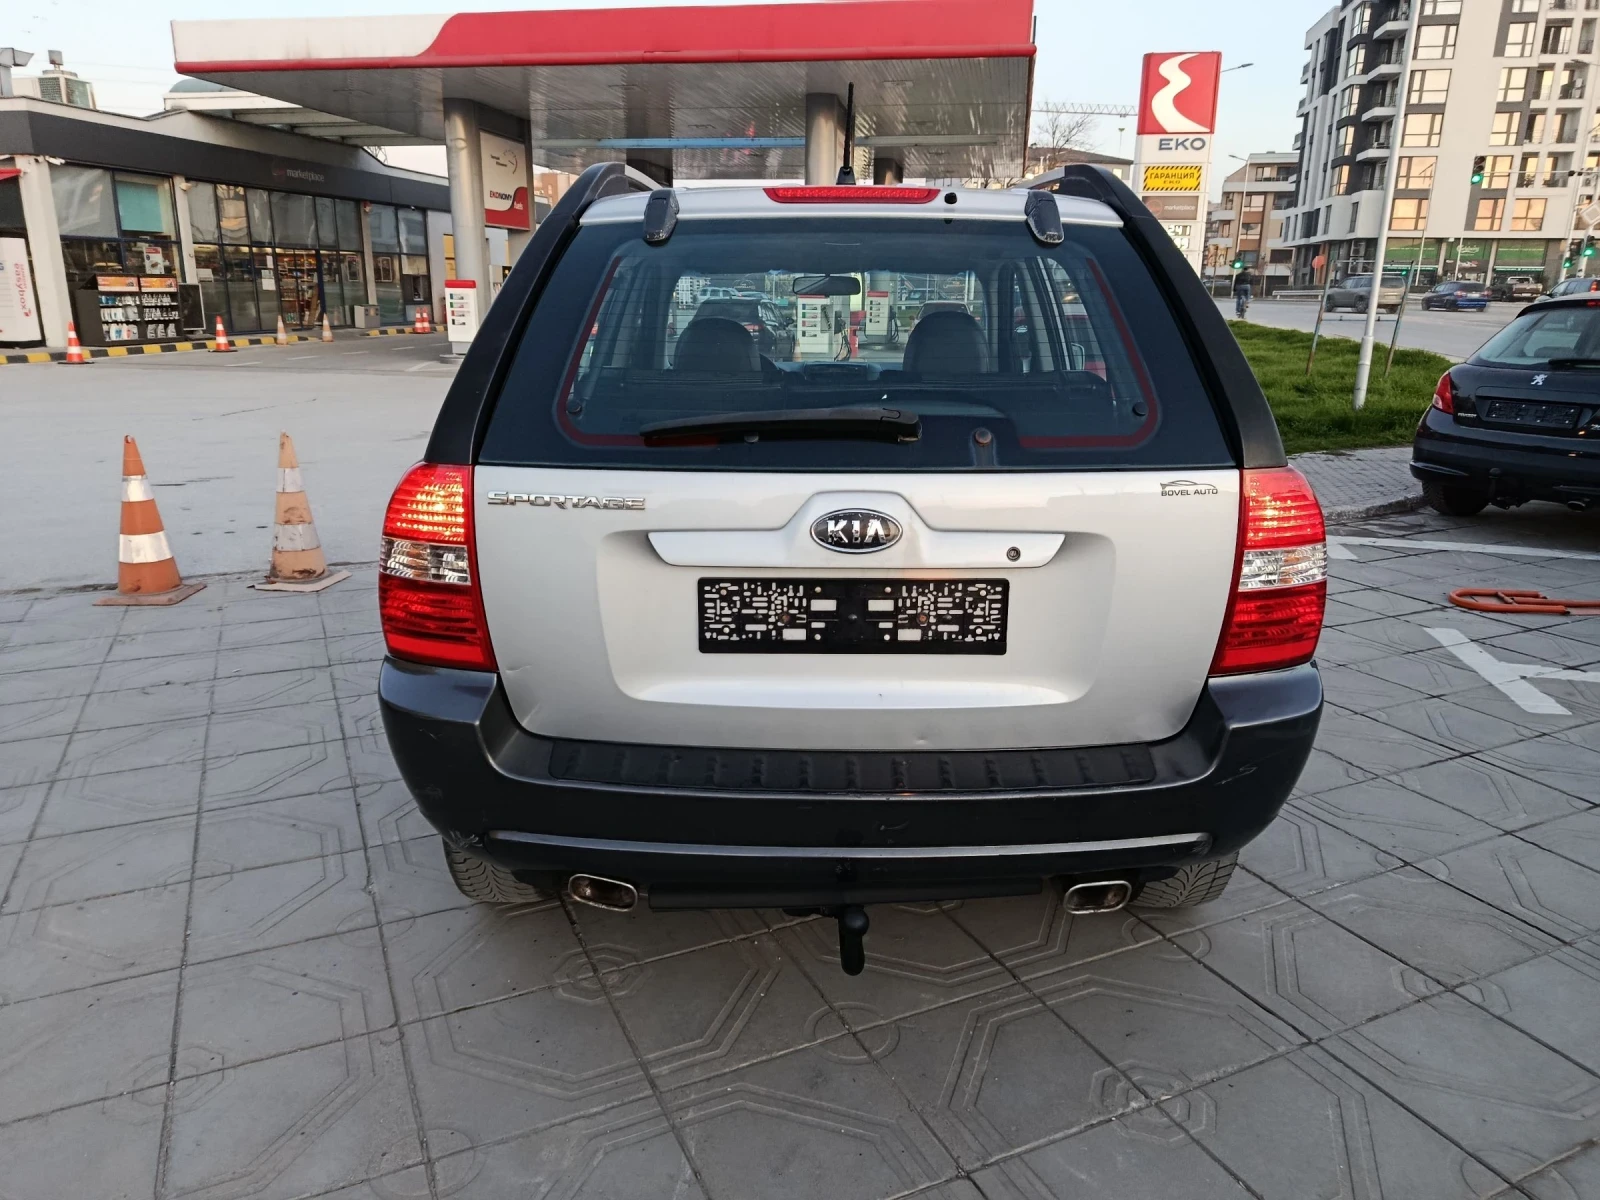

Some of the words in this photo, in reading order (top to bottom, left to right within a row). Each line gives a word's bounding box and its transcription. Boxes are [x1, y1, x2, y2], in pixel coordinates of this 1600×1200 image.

[1158, 137, 1206, 150] EKO
[286, 169, 325, 182] marketplace
[1149, 172, 1195, 180] ГАРАНЦИЯ
[489, 190, 512, 201] EKONOMY
[487, 490, 646, 510] SPORTAGE
[826, 519, 887, 544] KIA
